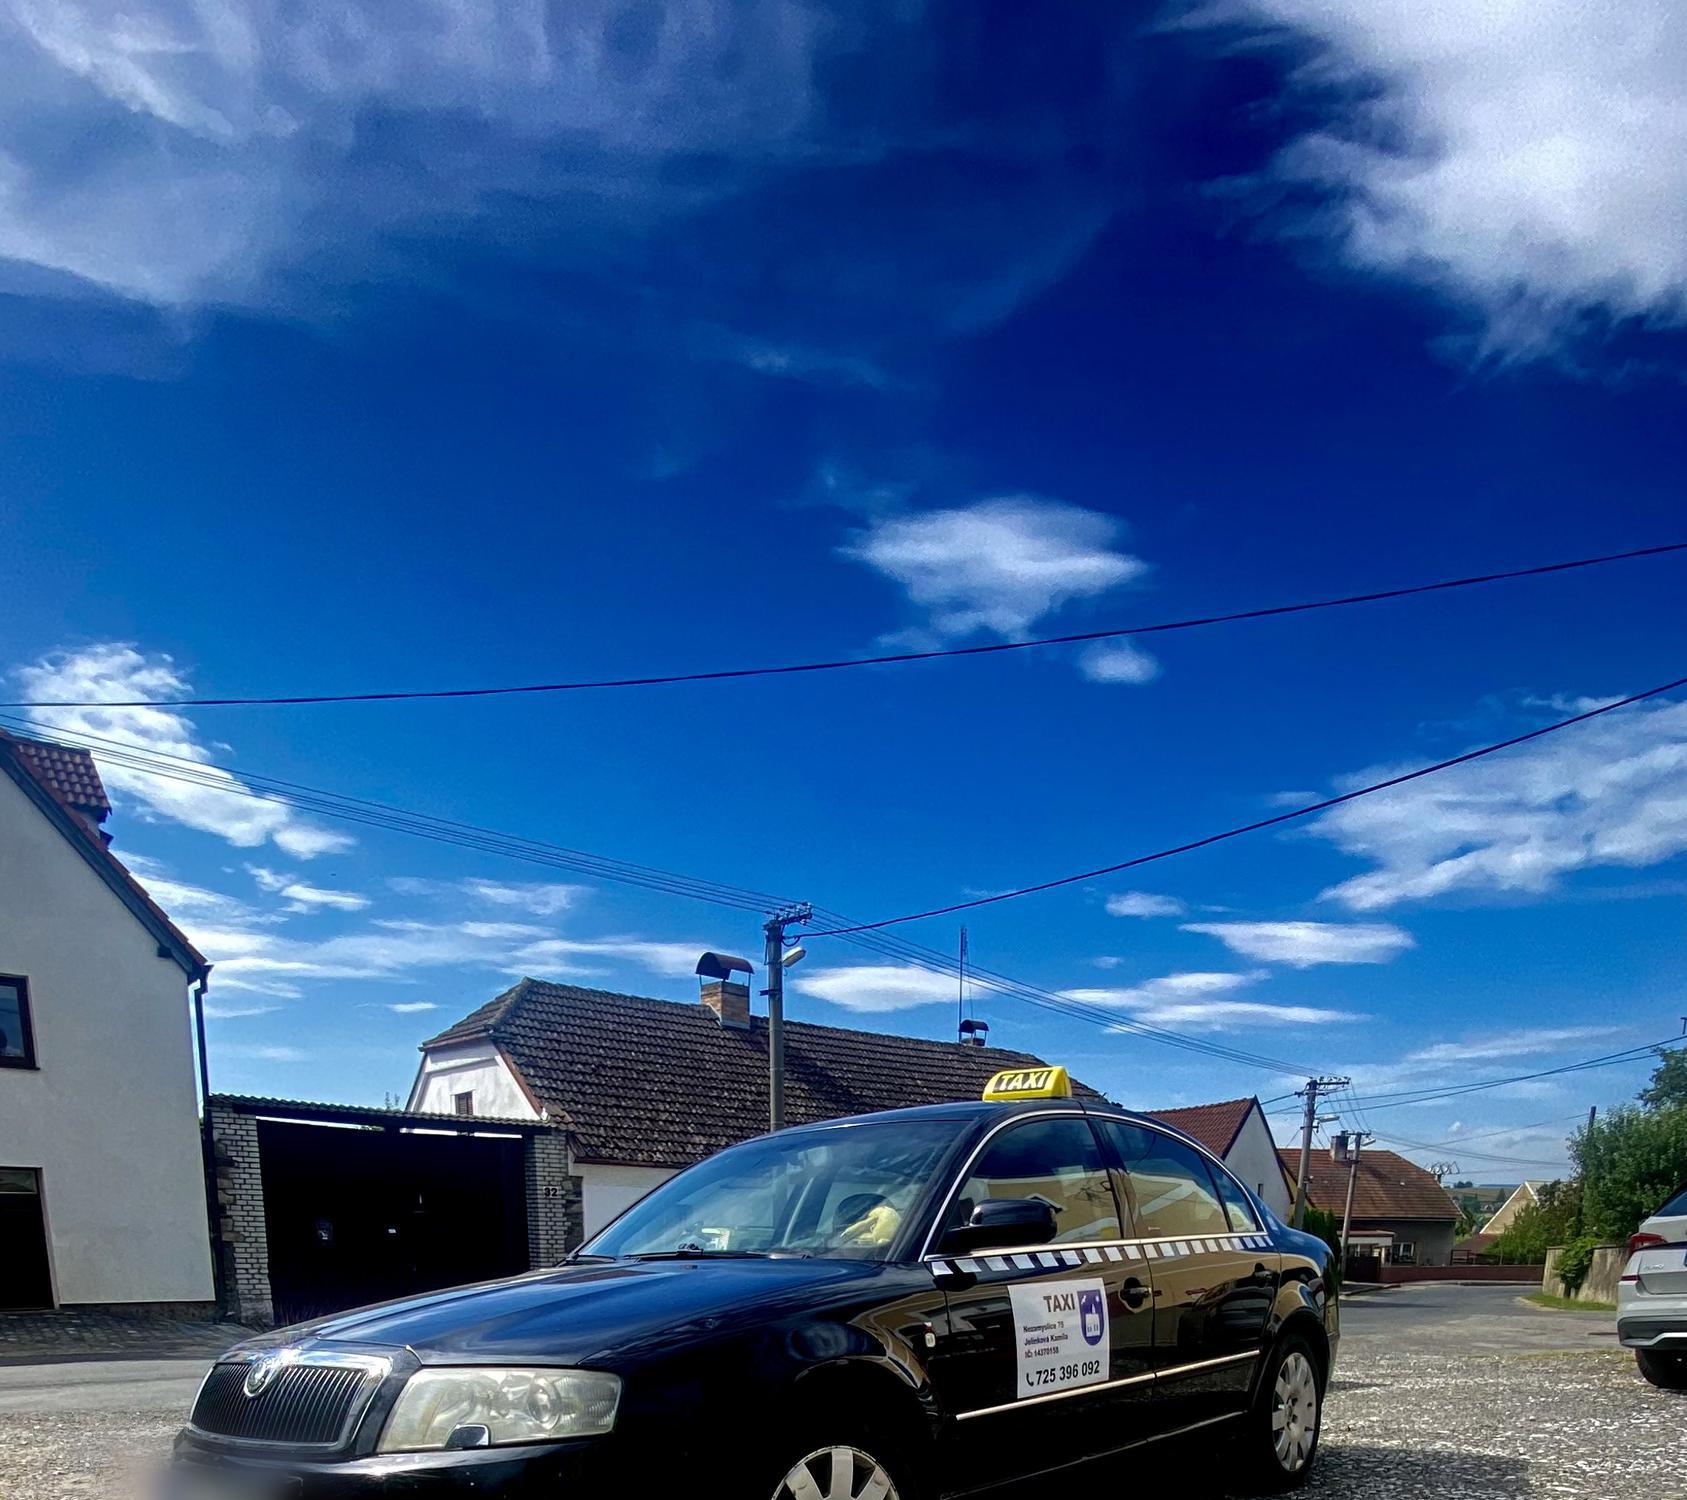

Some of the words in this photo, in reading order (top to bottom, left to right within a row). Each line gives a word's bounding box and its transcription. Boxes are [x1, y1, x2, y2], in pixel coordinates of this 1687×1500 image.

[999, 1071, 1049, 1091] TAXI
[544, 1187, 558, 1197] 32
[1043, 1293, 1076, 1313] TAXI
[1035, 1368, 1056, 1386] 725
[1060, 1364, 1079, 1381] 396
[1082, 1360, 1100, 1377] 092
